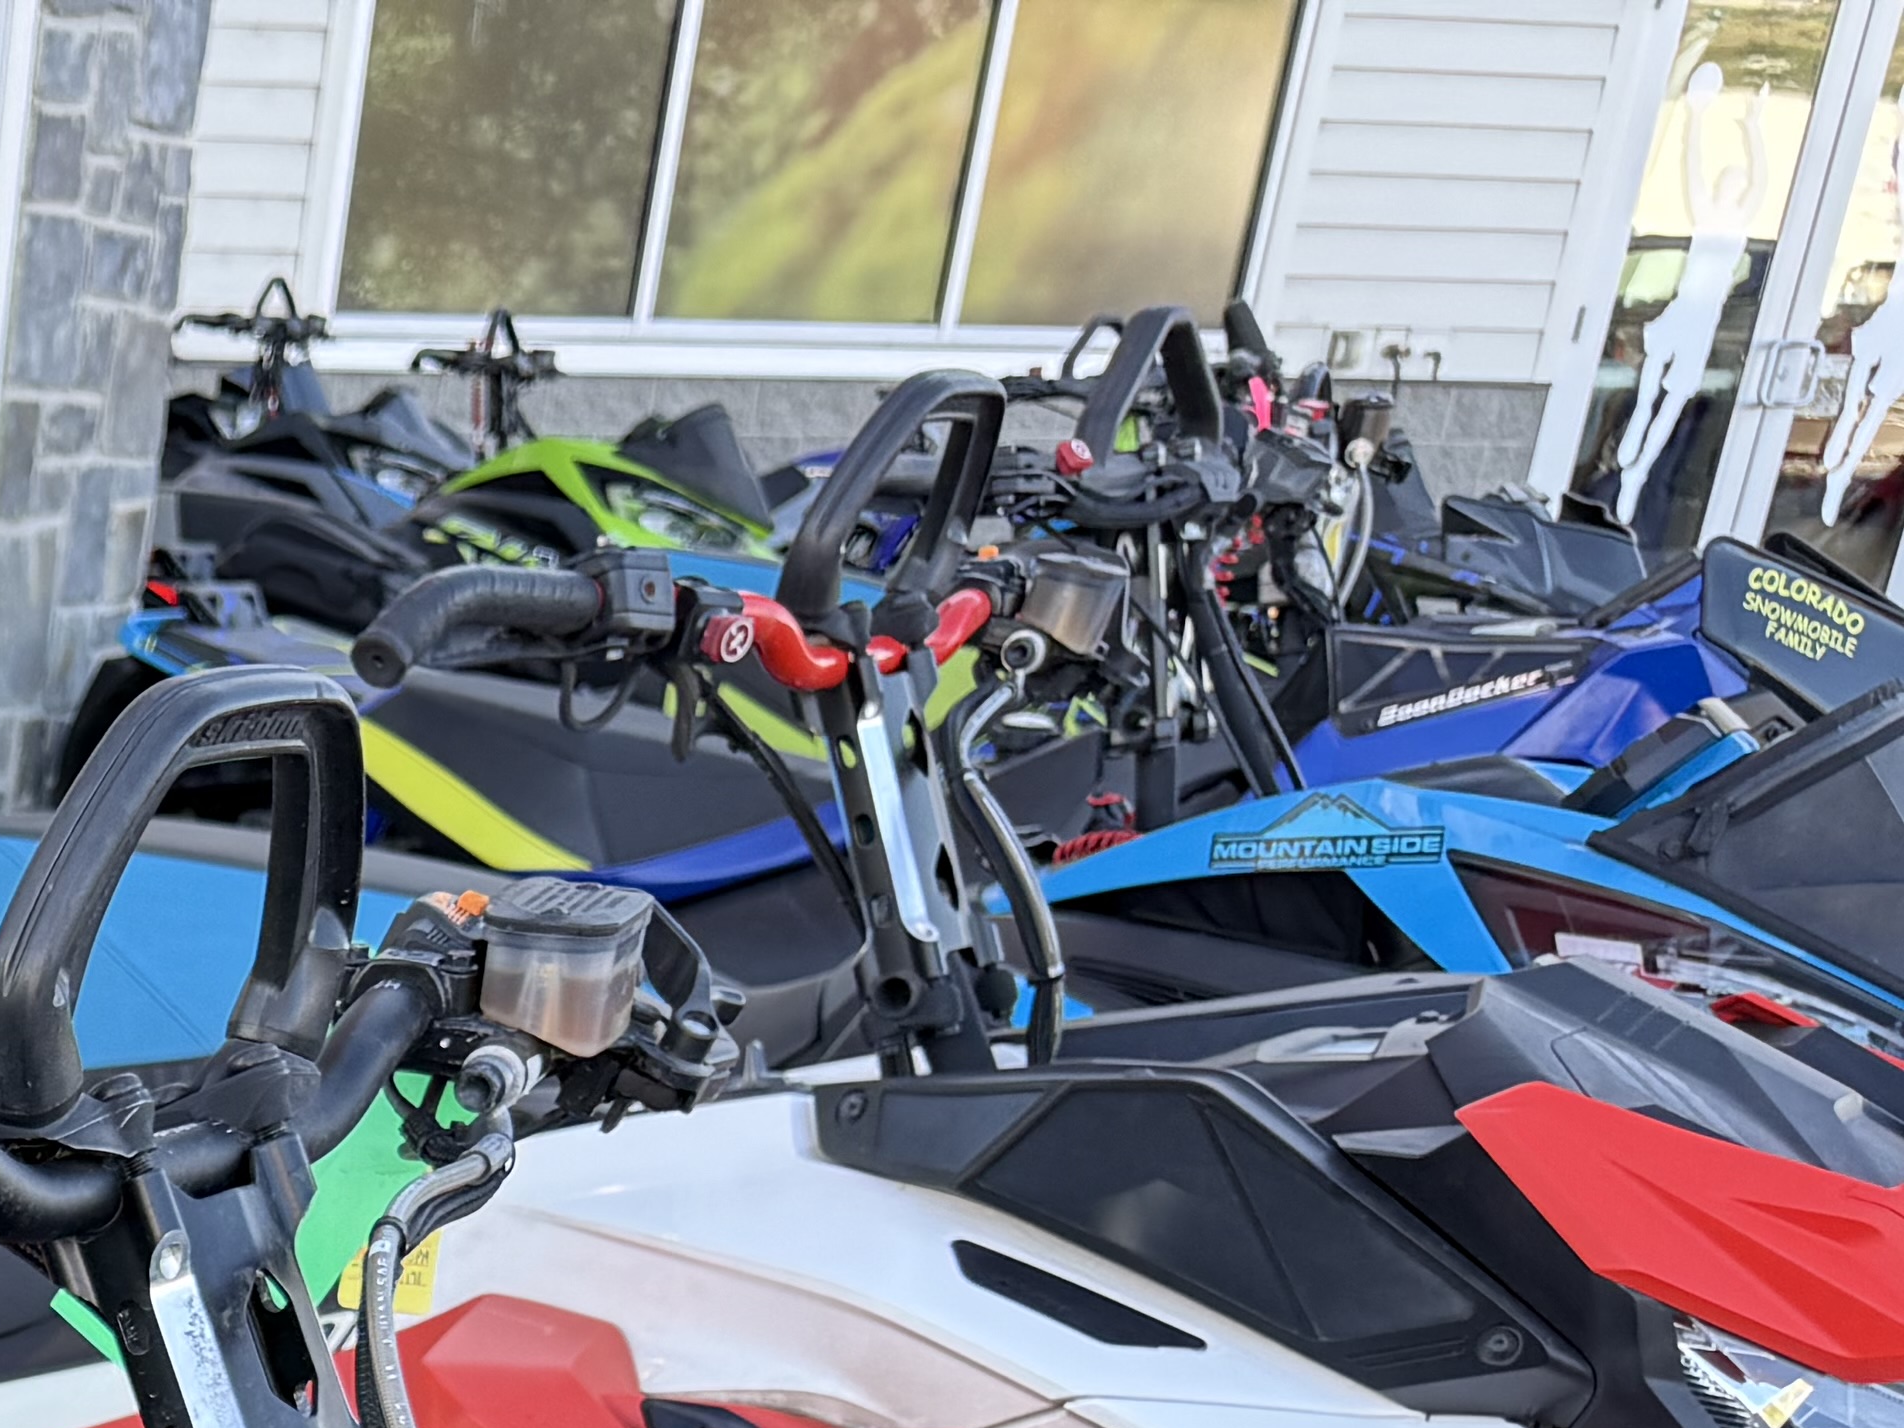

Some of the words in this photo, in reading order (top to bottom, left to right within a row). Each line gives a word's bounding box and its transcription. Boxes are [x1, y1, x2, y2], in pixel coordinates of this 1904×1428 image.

[1742, 591, 1858, 659] SNOWMOBILE
[1748, 567, 1865, 635] COLORADO
[1765, 620, 1827, 661] FAMILY
[1213, 838, 1369, 860] MOUNTAIN
[1371, 836, 1442, 855] SIDE
